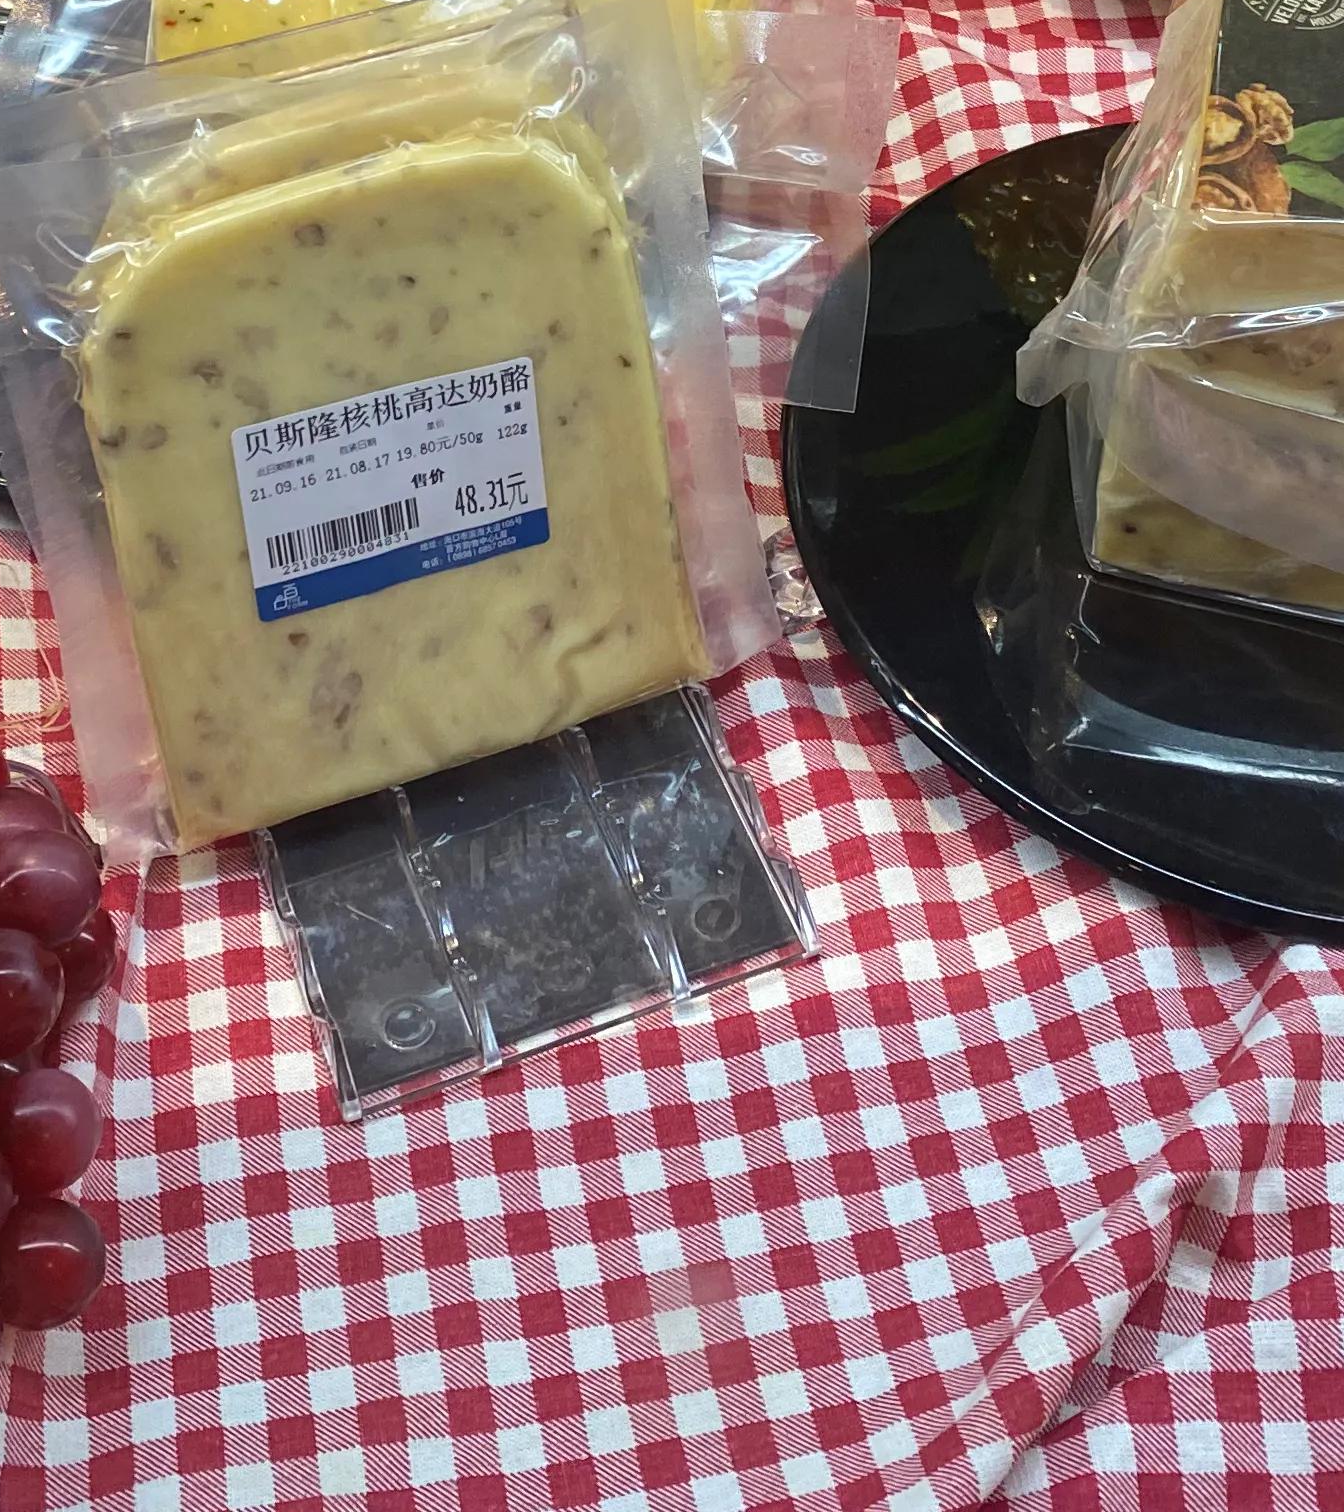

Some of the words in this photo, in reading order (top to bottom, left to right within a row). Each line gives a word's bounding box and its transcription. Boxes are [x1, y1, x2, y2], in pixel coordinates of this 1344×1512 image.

[244, 363, 532, 462] 贝斯隆核桃高达奶酪
[250, 473, 318, 503] 21.09.16
[325, 453, 390, 482] 21.08.17
[396, 431, 484, 463] 19.80元/50g
[497, 423, 529, 440] 122g
[410, 467, 447, 489] 售价
[454, 471, 530, 517] 48.31元
[282, 531, 411, 576] 22100290004831
